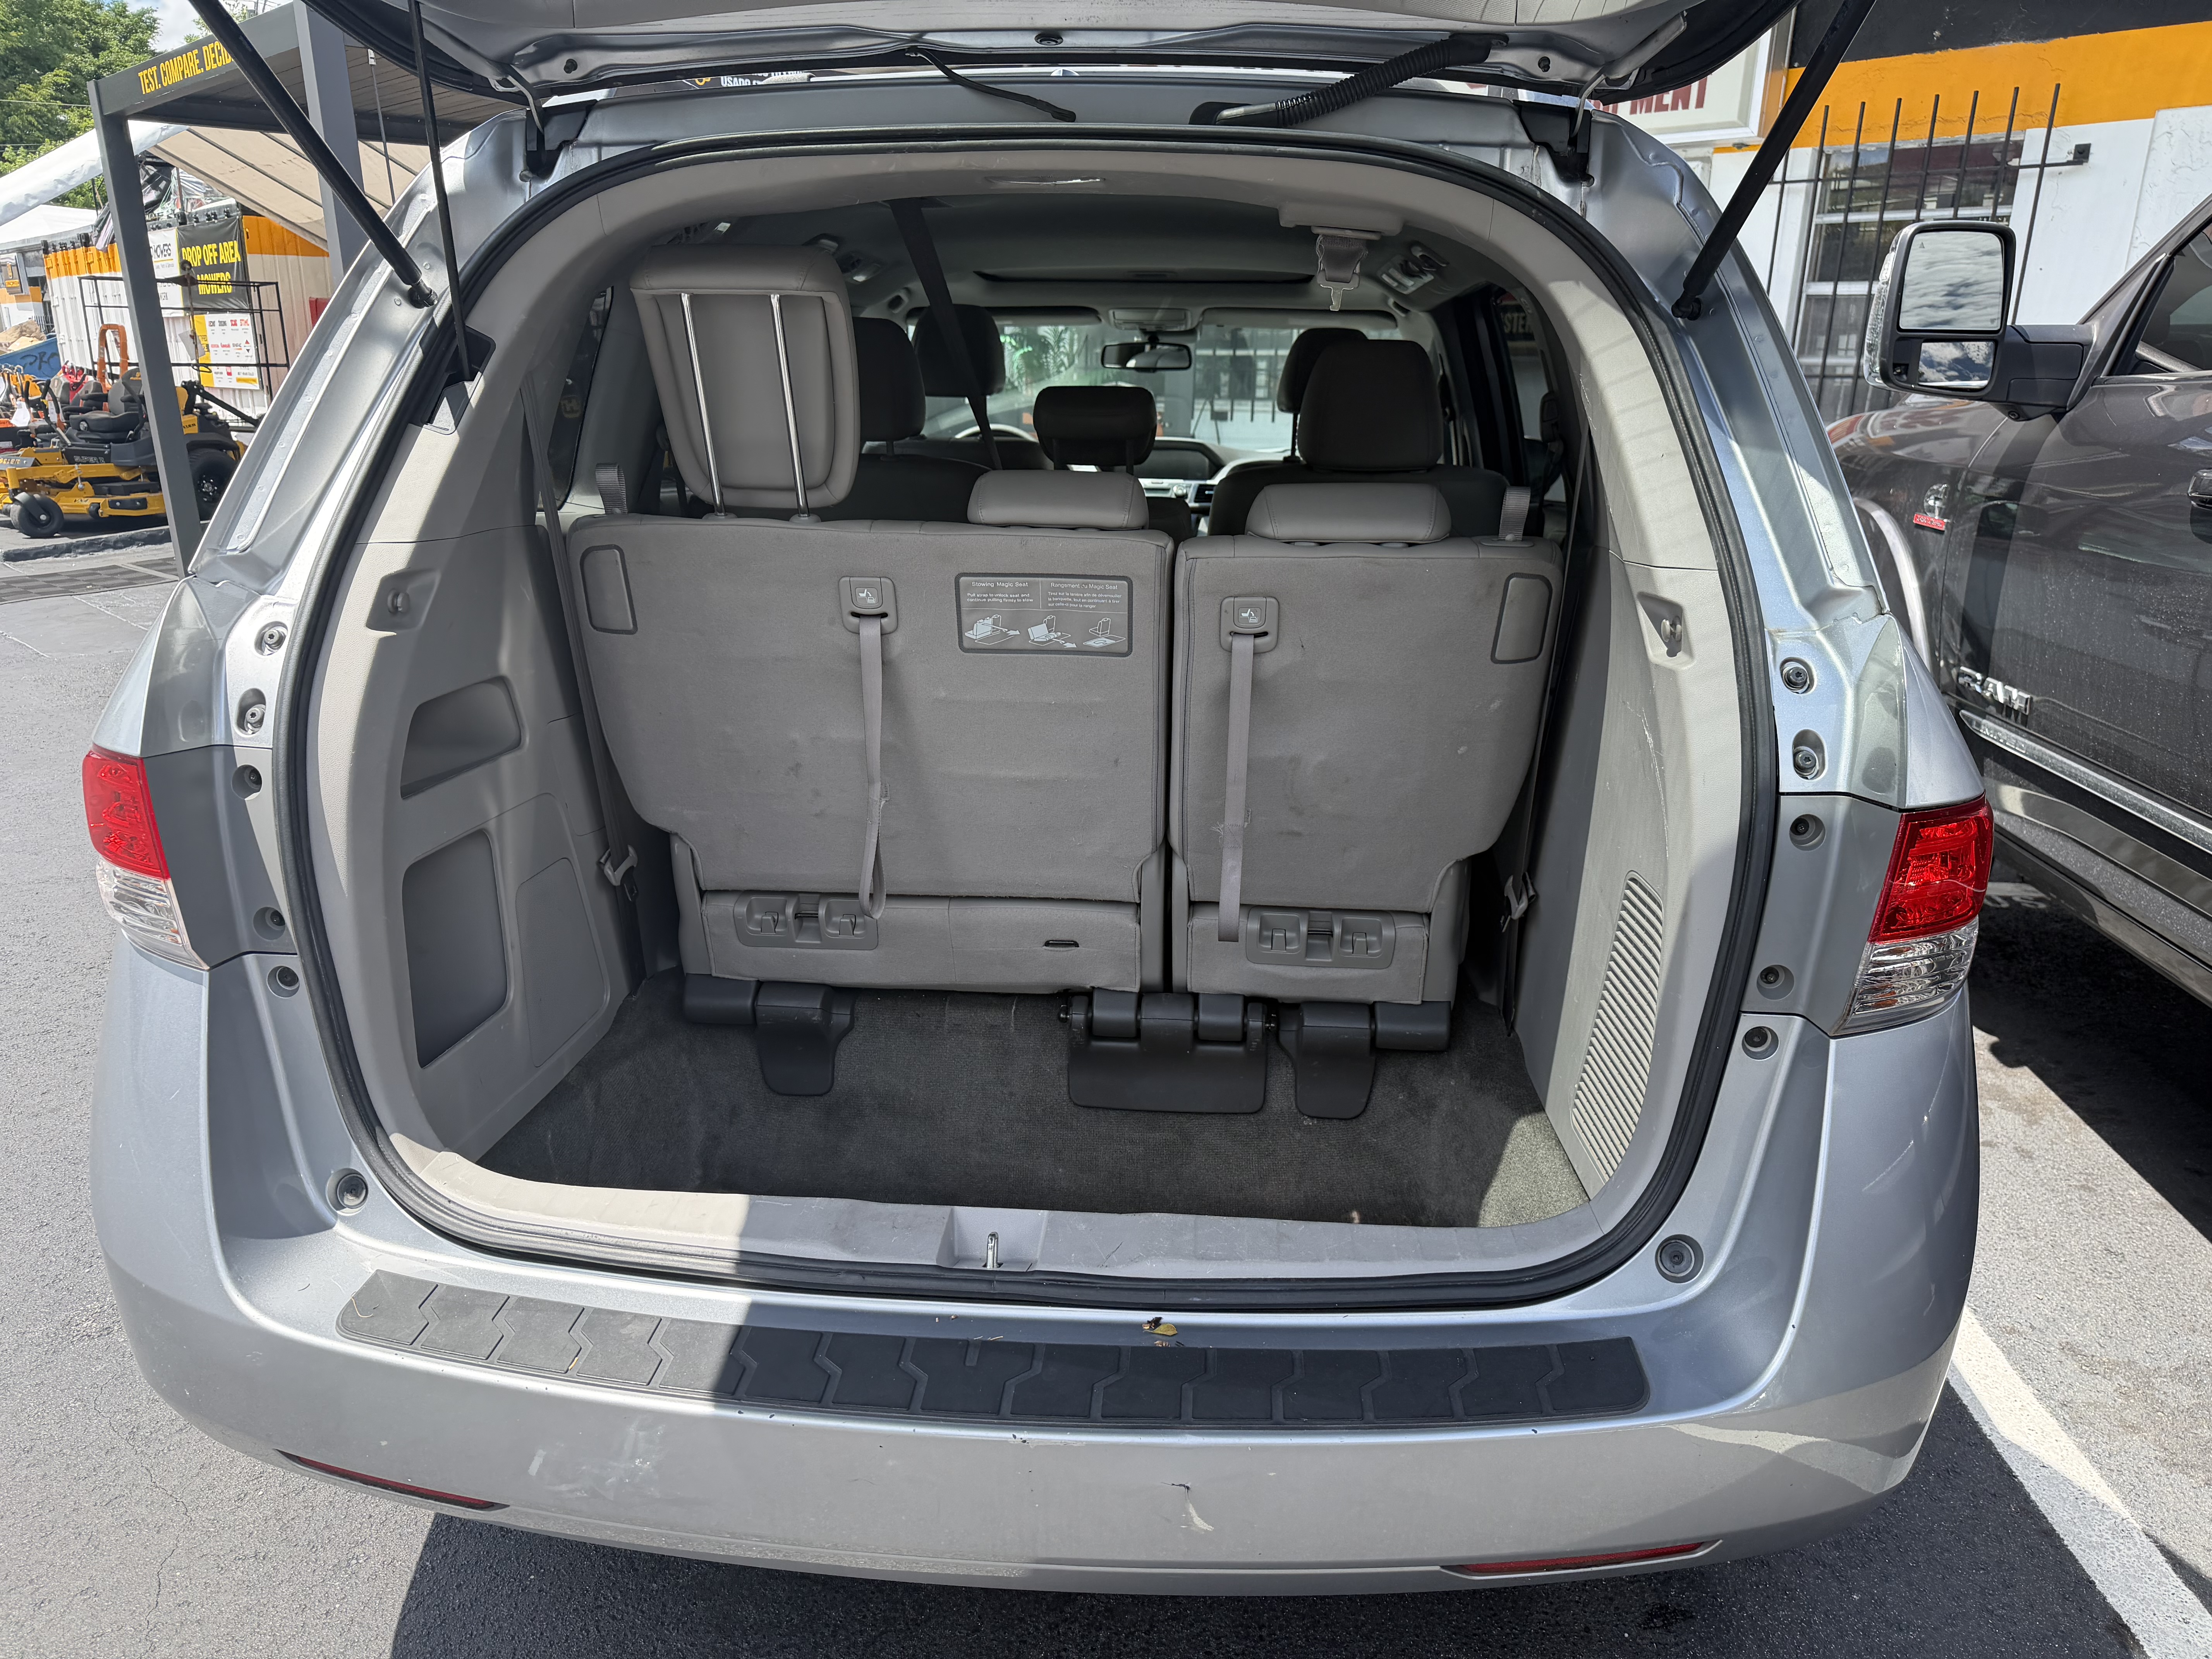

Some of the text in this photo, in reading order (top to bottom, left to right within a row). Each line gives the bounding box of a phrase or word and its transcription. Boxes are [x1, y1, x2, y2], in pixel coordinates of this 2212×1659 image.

[138, 41, 234, 94] TEST. COMPARE. DECID
[182, 240, 241, 267] DROP OFF AREA
[197, 272, 232, 295] MOWERS
[1958, 666, 2032, 716] RAM
